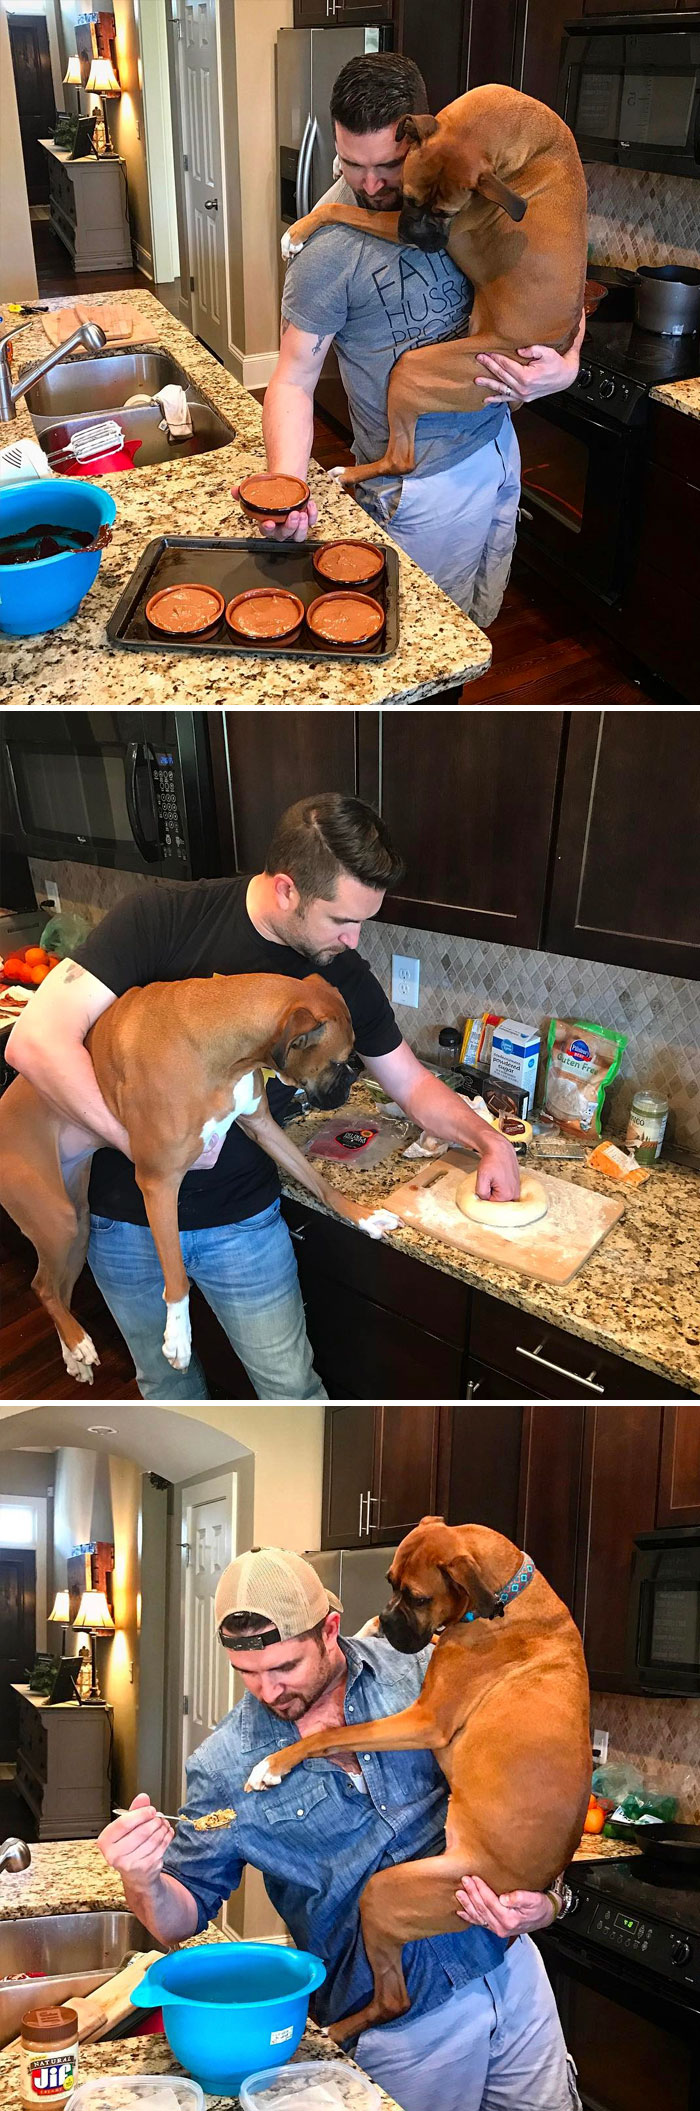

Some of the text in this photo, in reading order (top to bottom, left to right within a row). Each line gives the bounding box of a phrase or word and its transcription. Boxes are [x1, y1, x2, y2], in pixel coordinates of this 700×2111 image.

[493, 1057, 521, 1071] powdered
[33, 2056, 72, 2067] NATURAL
[34, 2063, 72, 2089] Jif
